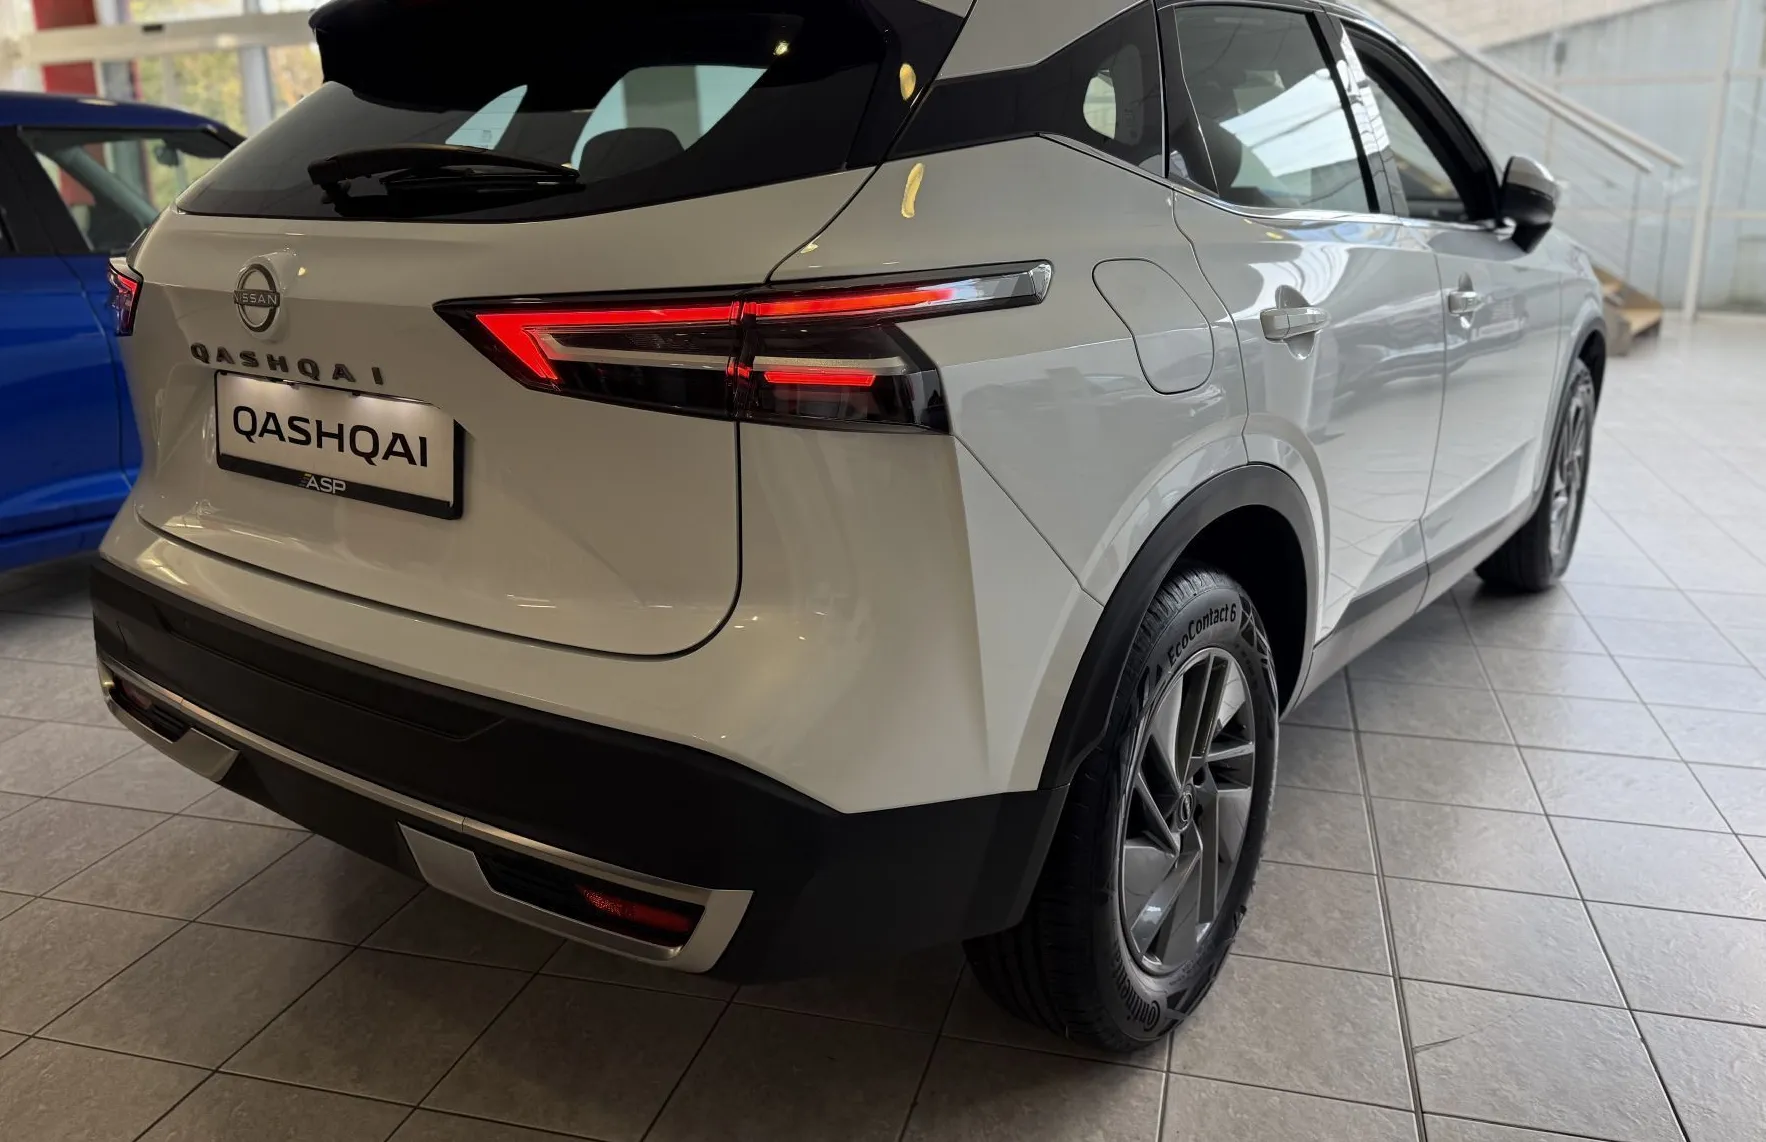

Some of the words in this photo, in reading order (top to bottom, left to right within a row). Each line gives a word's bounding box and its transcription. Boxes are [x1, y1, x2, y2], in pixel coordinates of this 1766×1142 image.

[233, 289, 278, 305] NISSAN
[190, 342, 384, 385] QASHQAI
[233, 405, 428, 467] QASHQAI
[306, 475, 346, 494] ASP
[1167, 603, 1229, 668] EcoContact
[1230, 603, 1237, 622] 6
